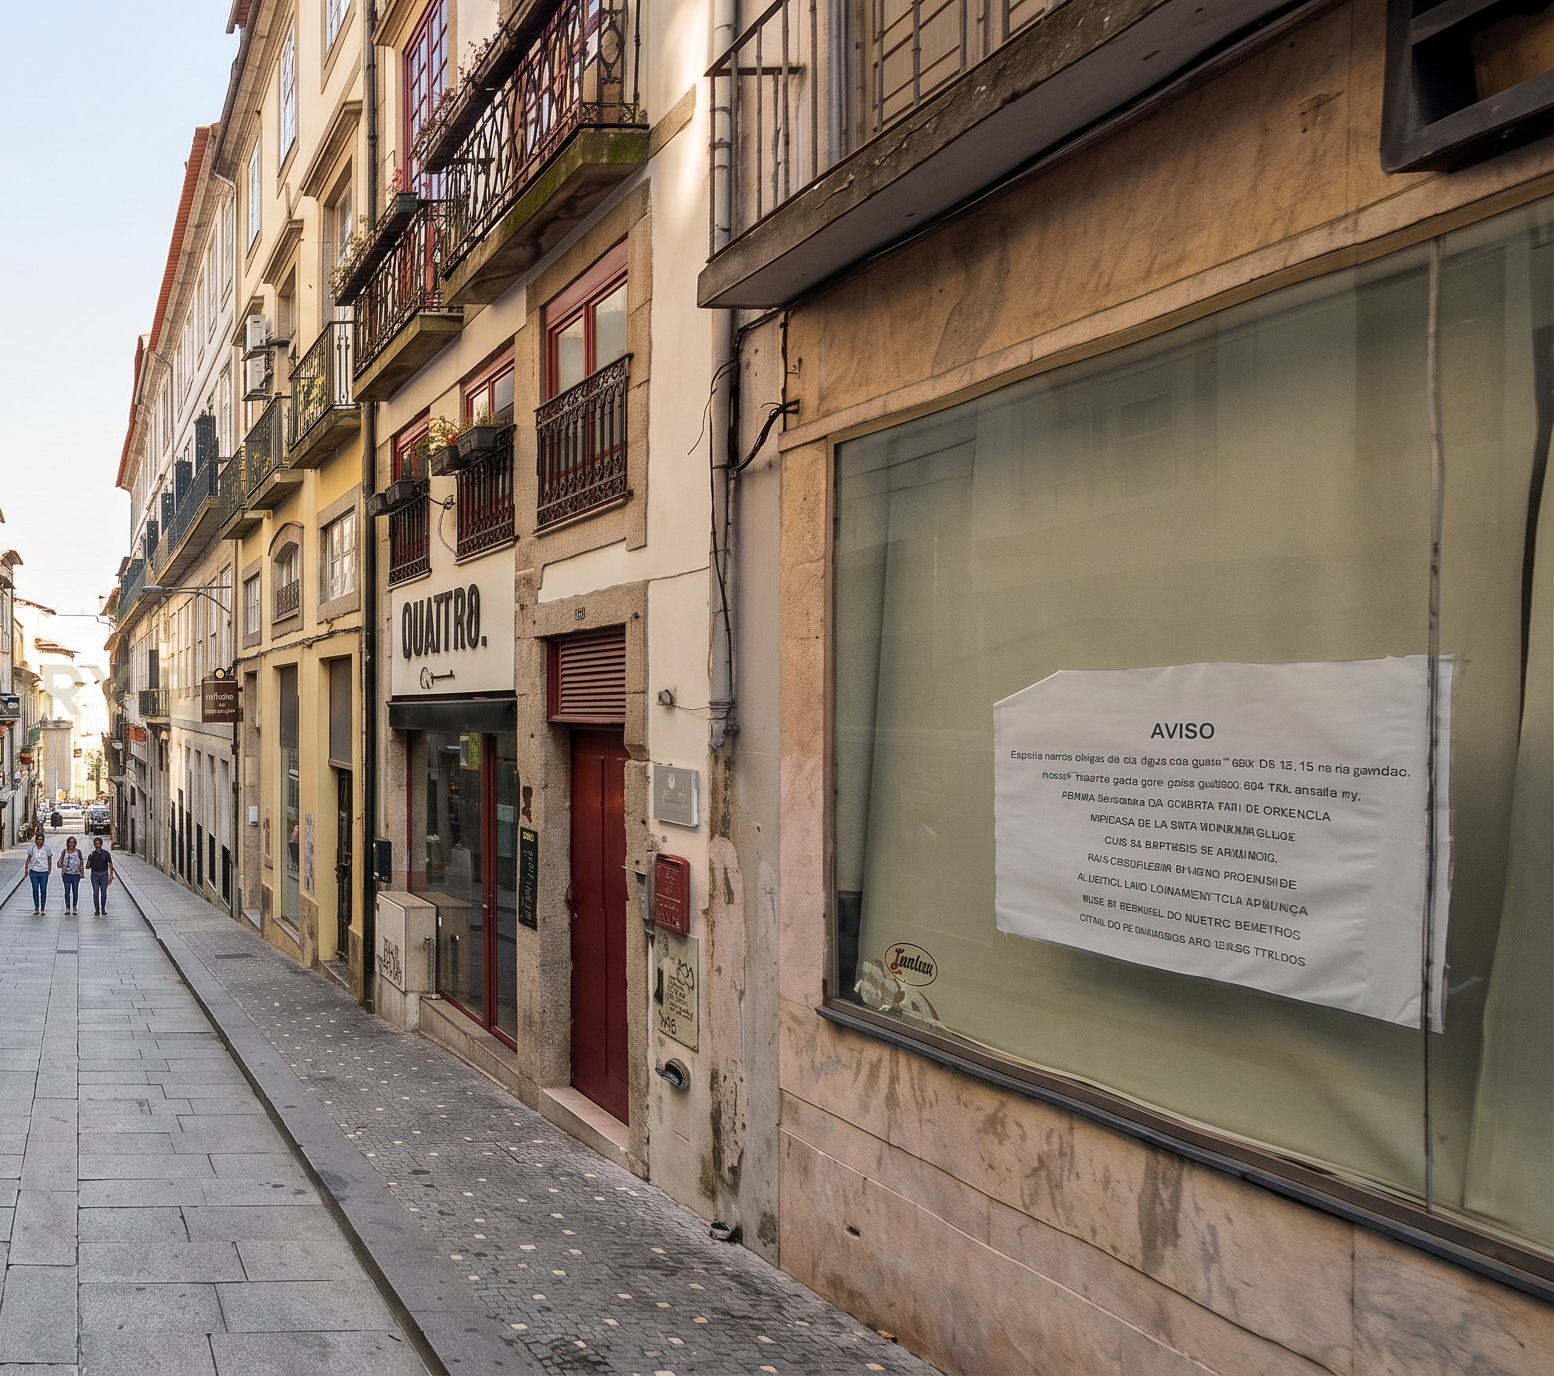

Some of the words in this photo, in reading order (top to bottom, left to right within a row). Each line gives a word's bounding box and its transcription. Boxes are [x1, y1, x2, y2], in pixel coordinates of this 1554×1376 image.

[1150, 722, 1215, 740] AVISO
[1107, 755, 1120, 764] de
[1246, 804, 1259, 814] DE
[1155, 820, 1168, 829] LA
[1201, 846, 1213, 856] SE
[1167, 910, 1182, 921] DO
[1107, 920, 1121, 930] DO
[1188, 936, 1211, 948] ARO
